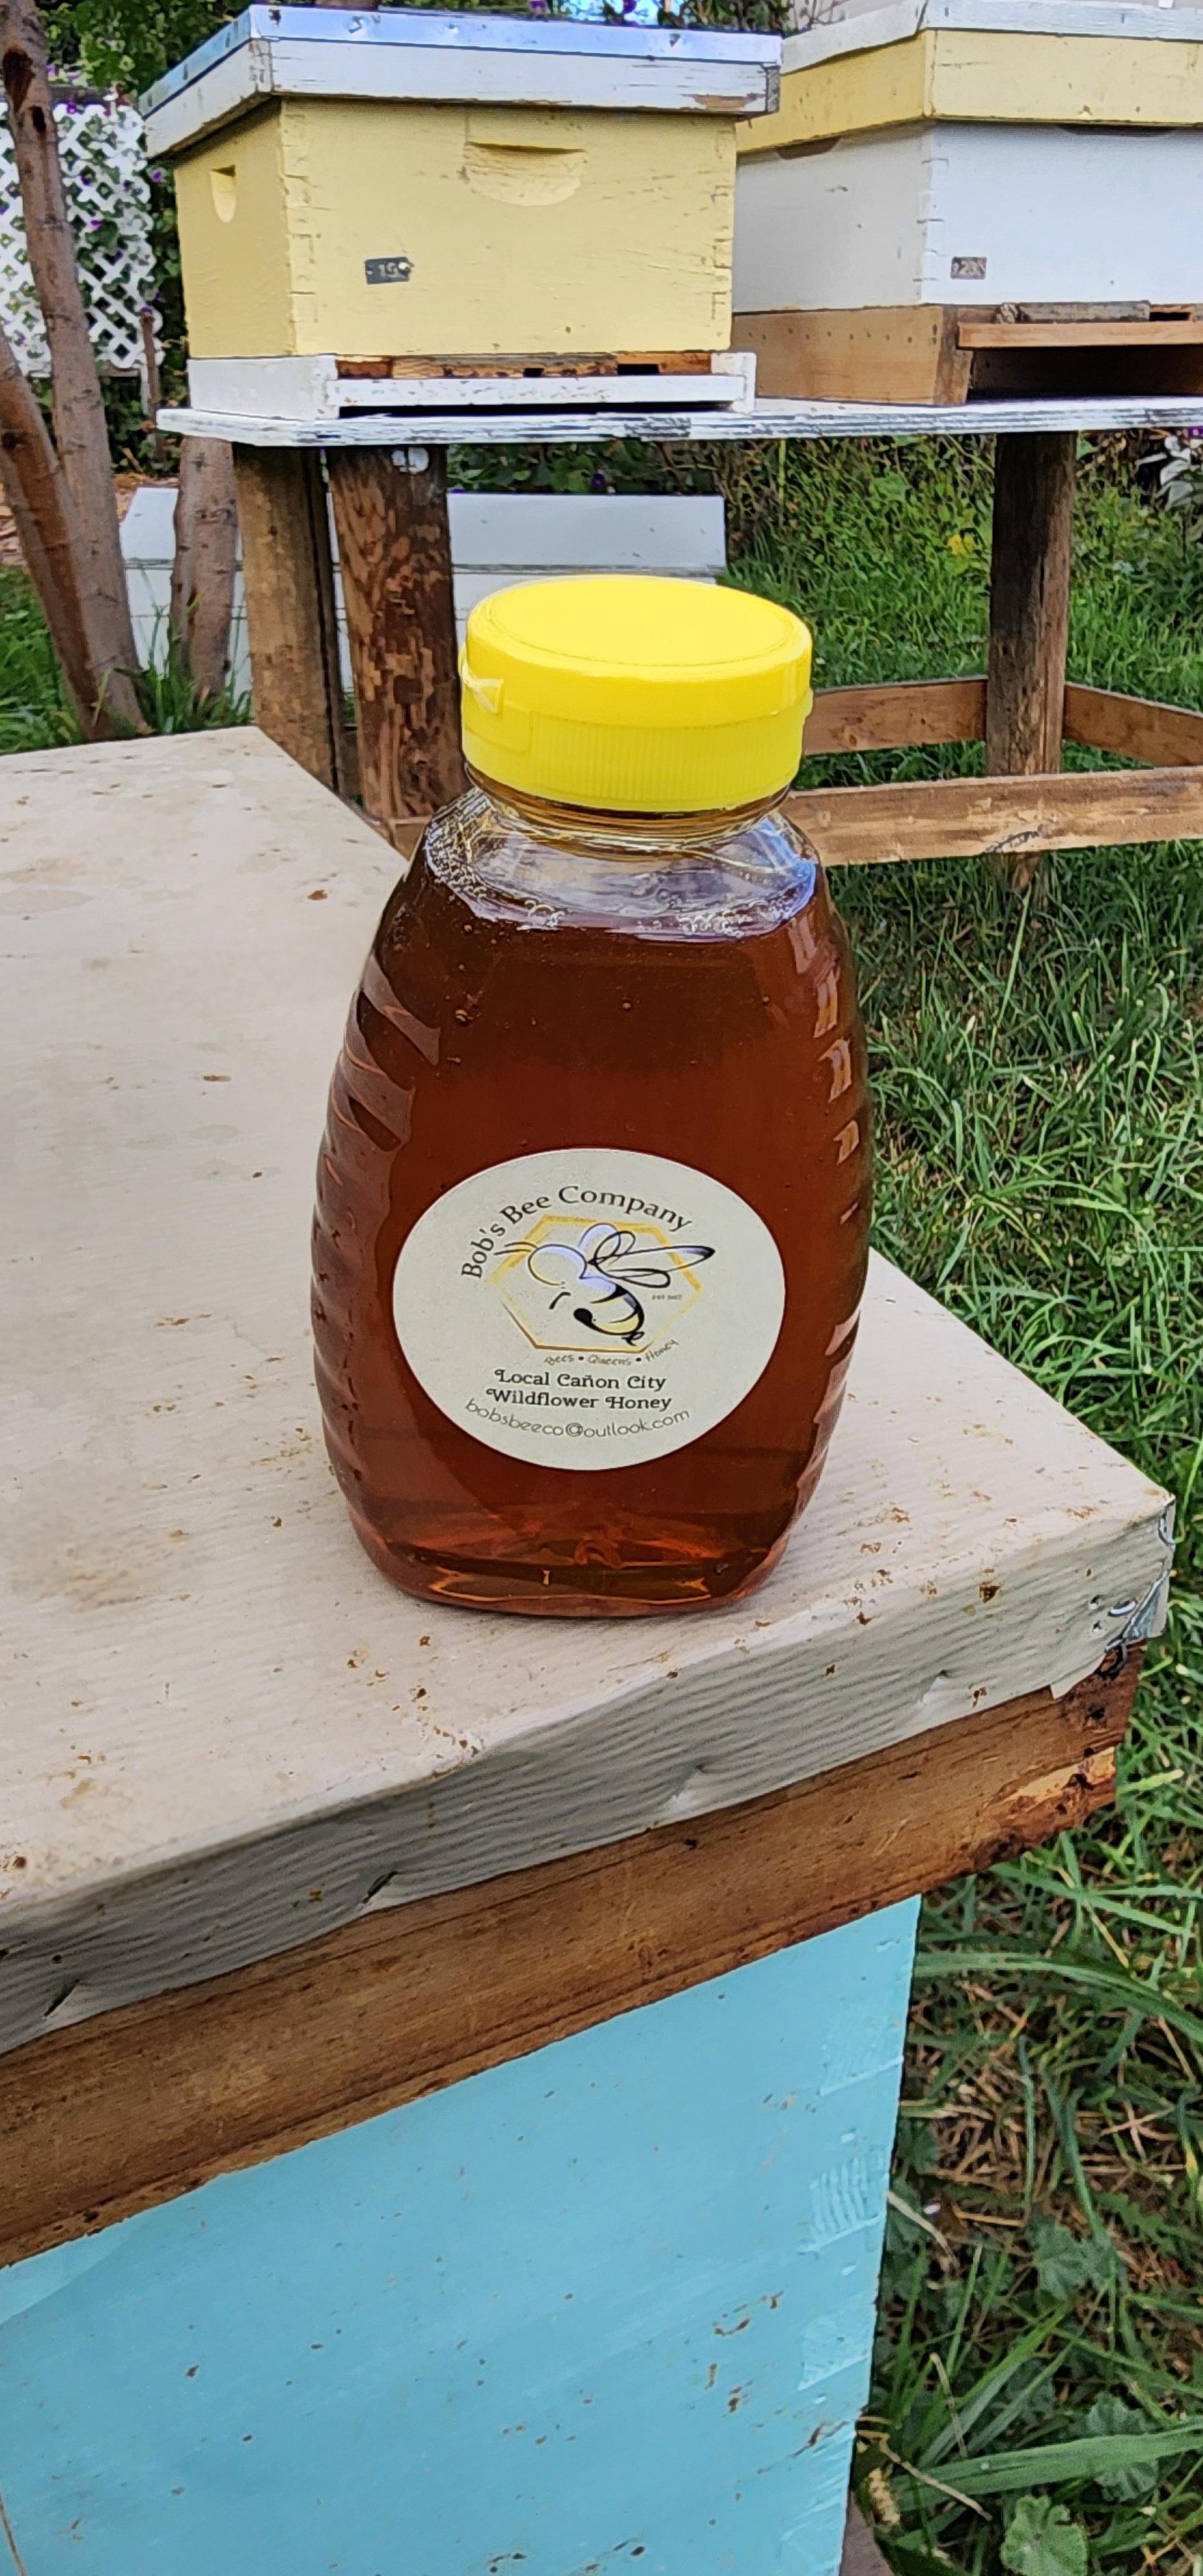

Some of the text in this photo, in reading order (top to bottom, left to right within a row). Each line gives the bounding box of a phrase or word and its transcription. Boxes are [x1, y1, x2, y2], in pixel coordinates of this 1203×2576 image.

[460, 1186, 692, 1280] Bob's Bee Company
[544, 1354, 574, 1366] Bees
[645, 1339, 679, 1361] Honey
[494, 1369, 667, 1392] Local Cañon City
[486, 1388, 672, 1412] Wildflower Honey
